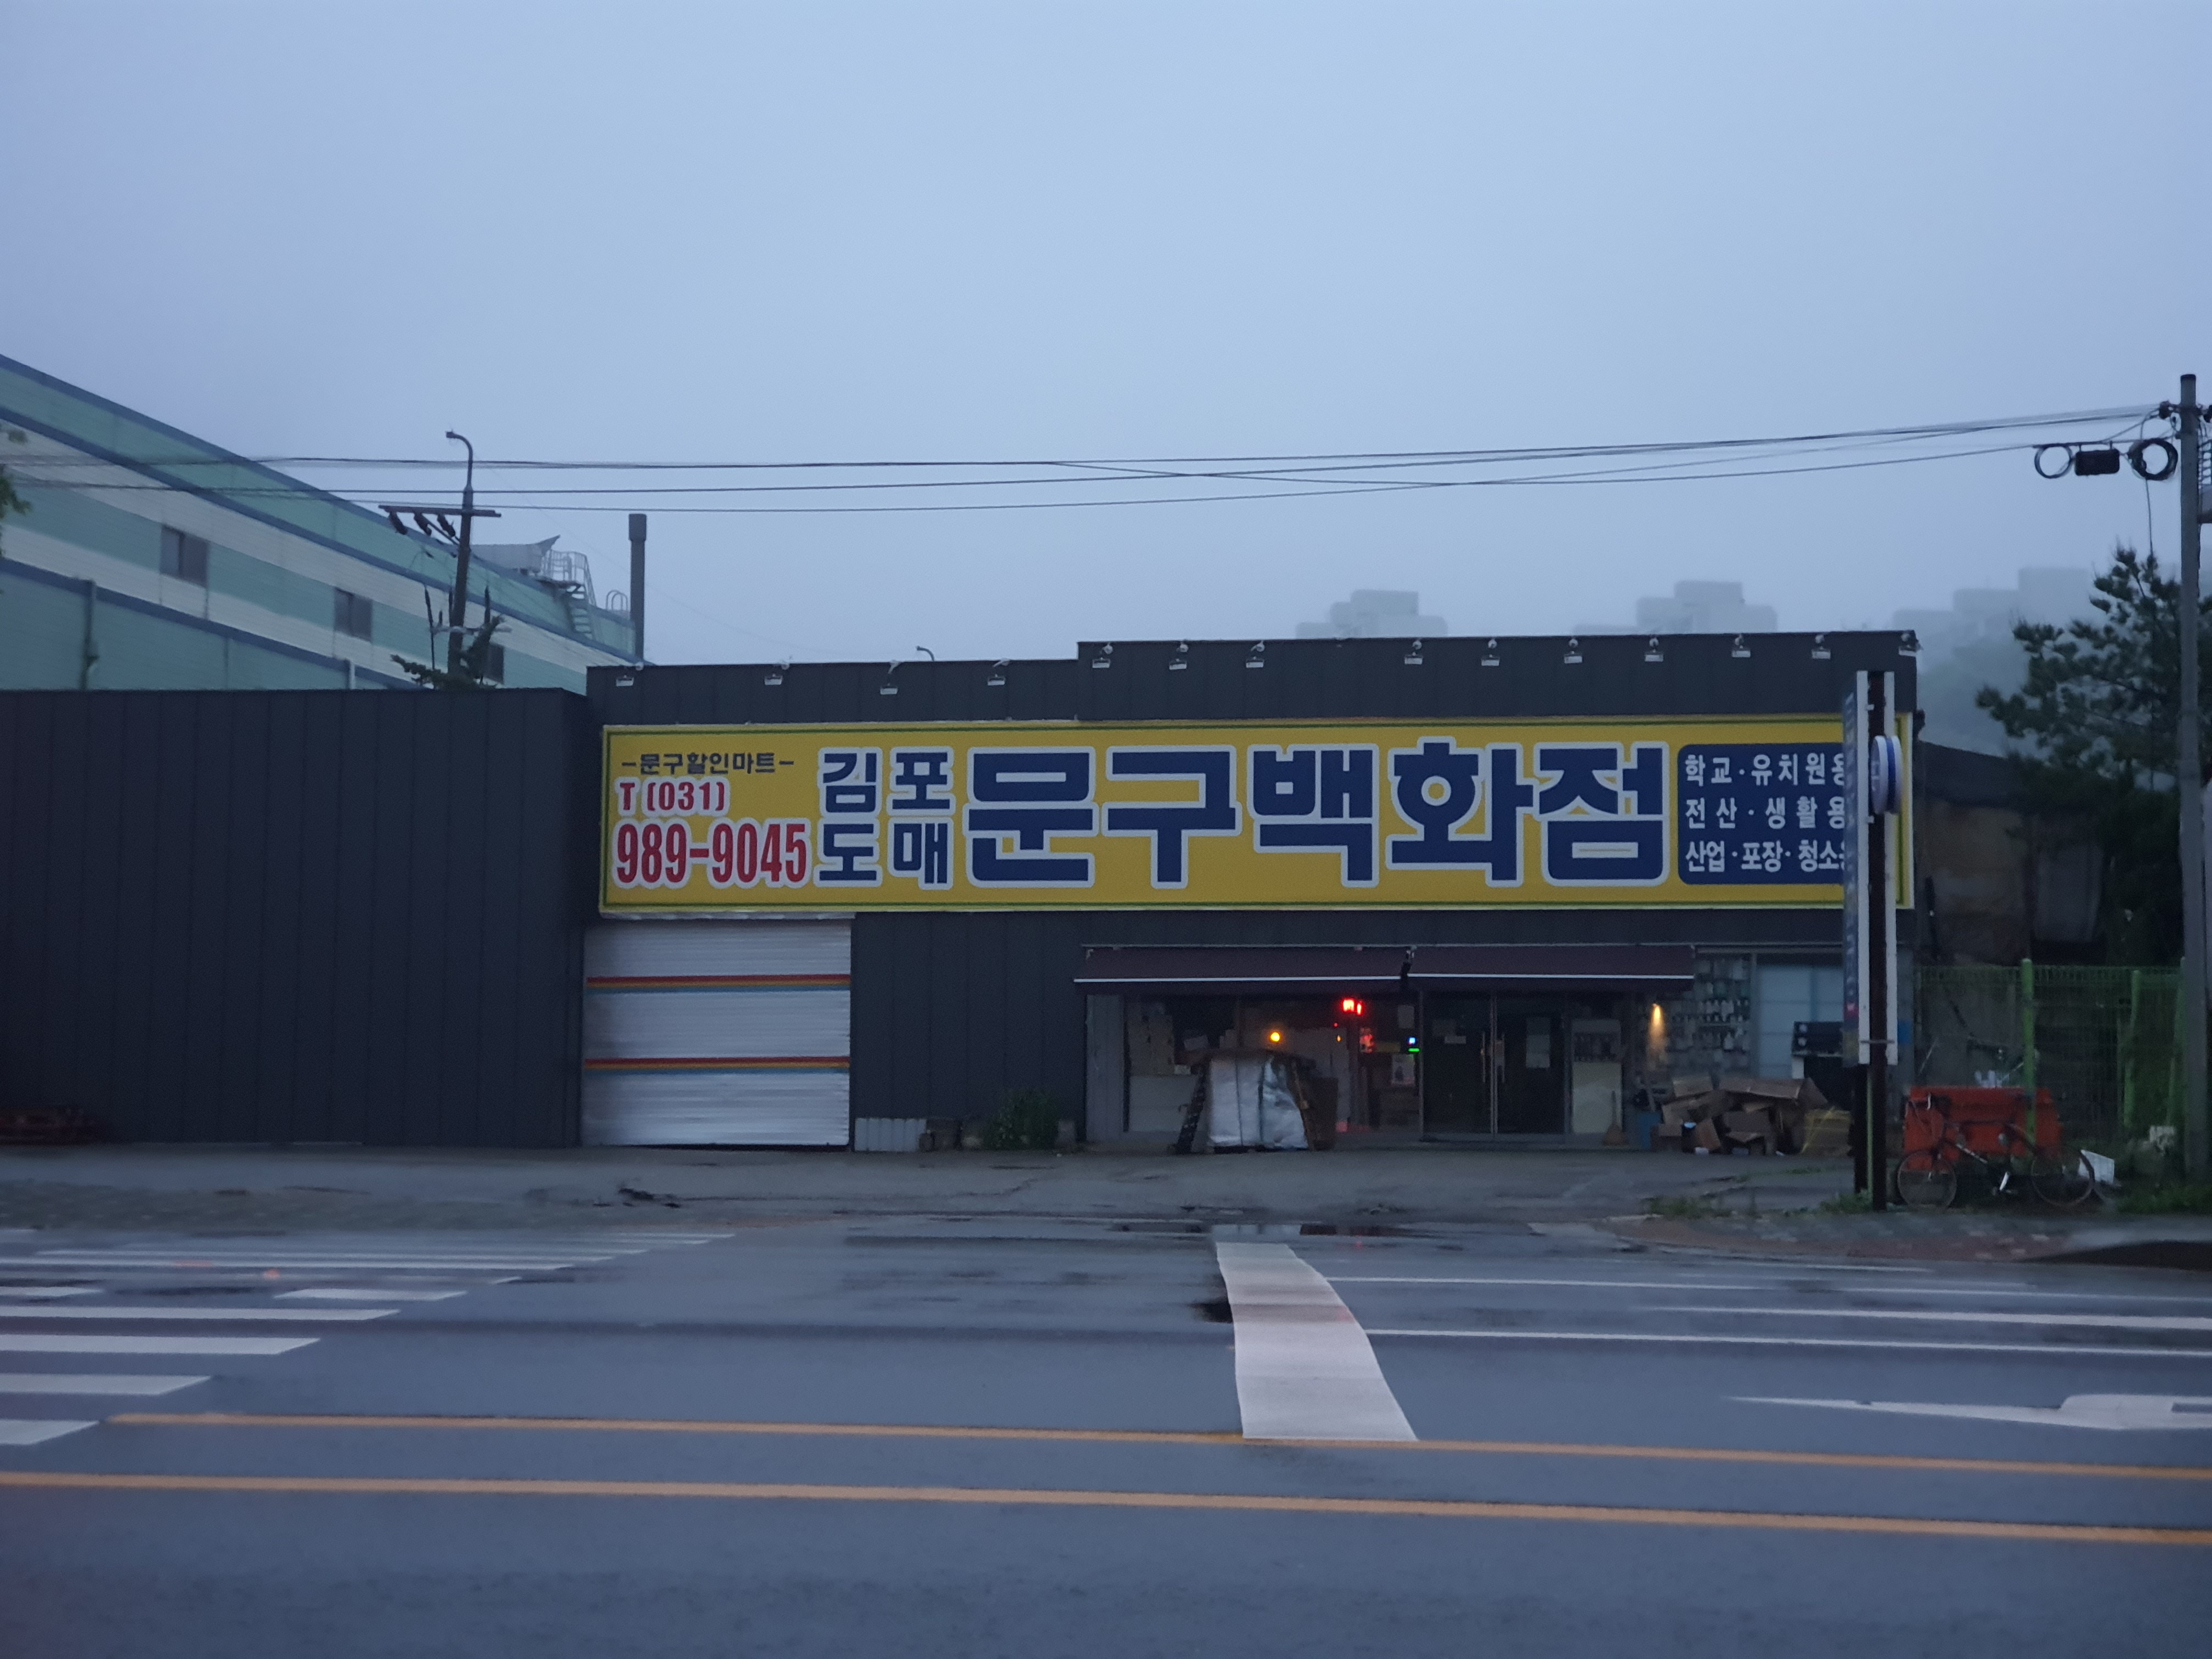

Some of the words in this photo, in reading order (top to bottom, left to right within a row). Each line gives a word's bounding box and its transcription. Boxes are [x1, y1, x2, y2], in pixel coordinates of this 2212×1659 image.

[823, 752, 950, 812] 김포
[969, 742, 1663, 883] 문구백화점
[617, 823, 806, 883] 989-9045
[819, 823, 948, 884] 도매
